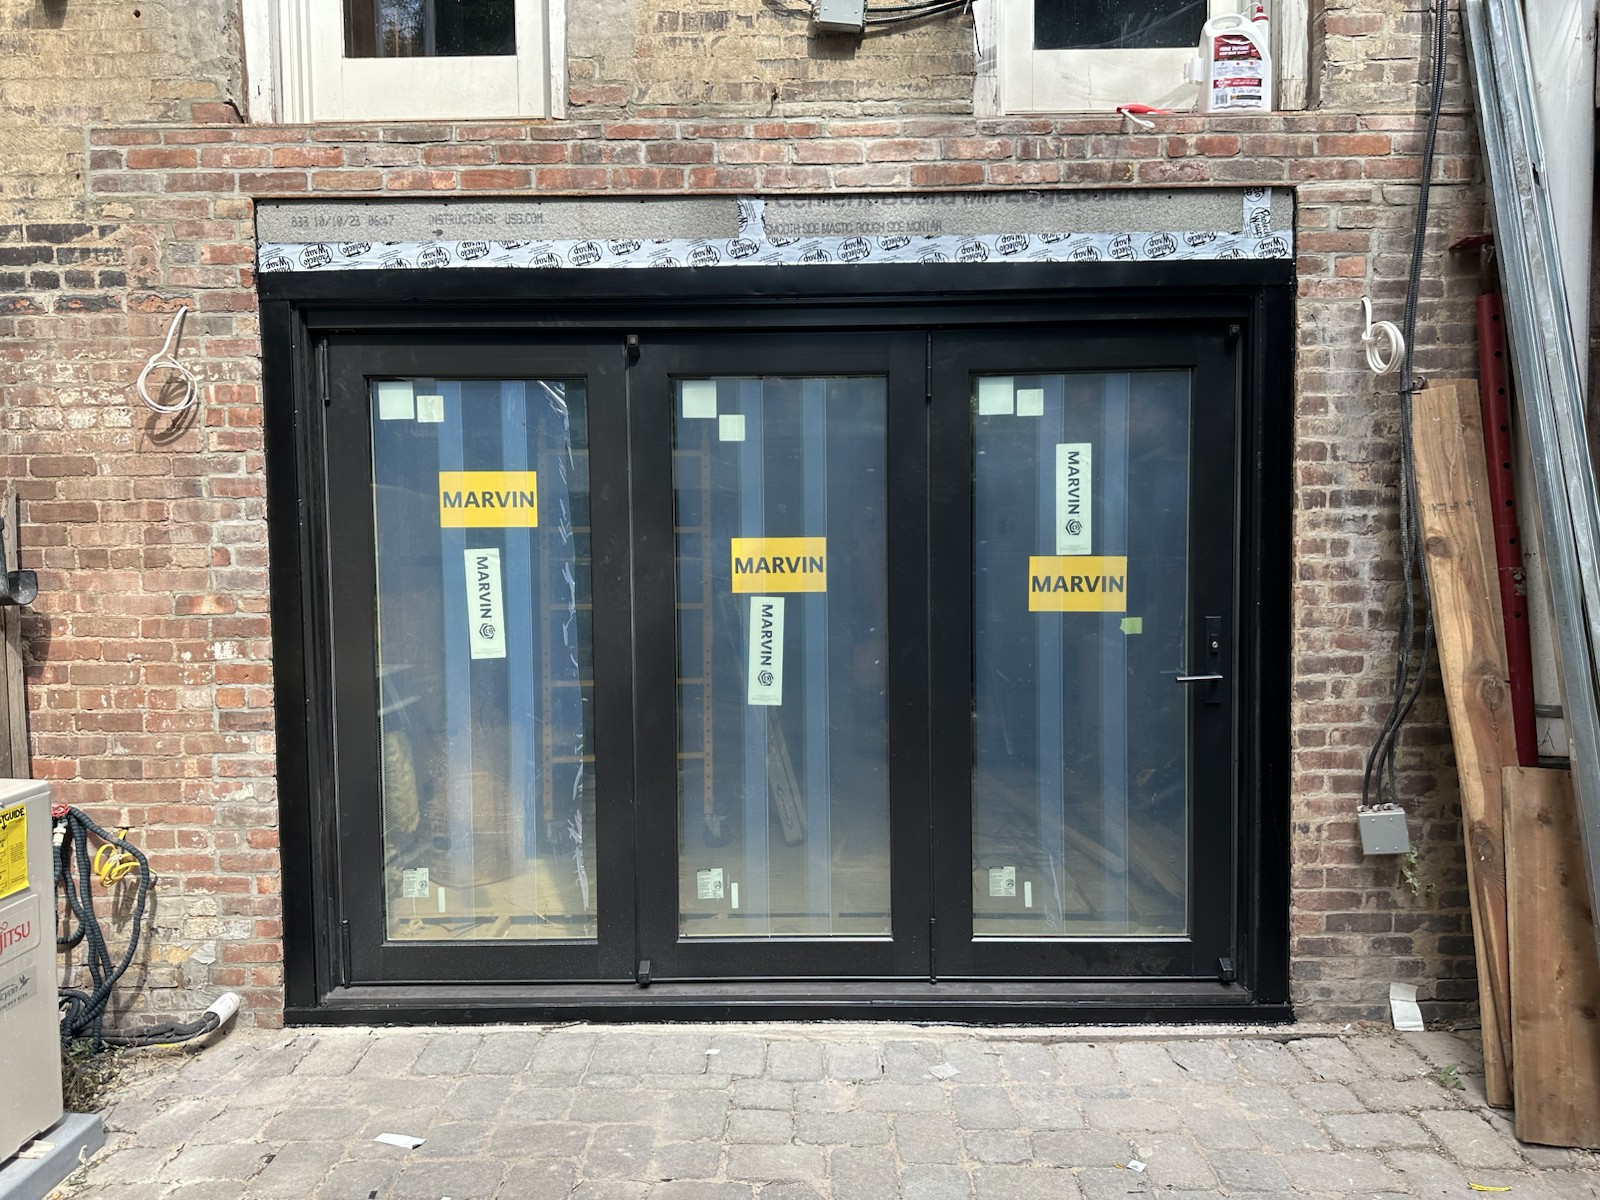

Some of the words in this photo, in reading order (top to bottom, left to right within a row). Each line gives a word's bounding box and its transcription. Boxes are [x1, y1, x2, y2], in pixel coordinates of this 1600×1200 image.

[822, 222, 851, 234] MASTIC
[1068, 451, 1080, 514] MARVIN
[443, 491, 534, 508] MARVIN
[735, 556, 824, 574] MARVIN
[476, 556, 493, 619] MARVIN
[1032, 576, 1124, 593] MARVIN
[760, 604, 774, 666] MARVIN
